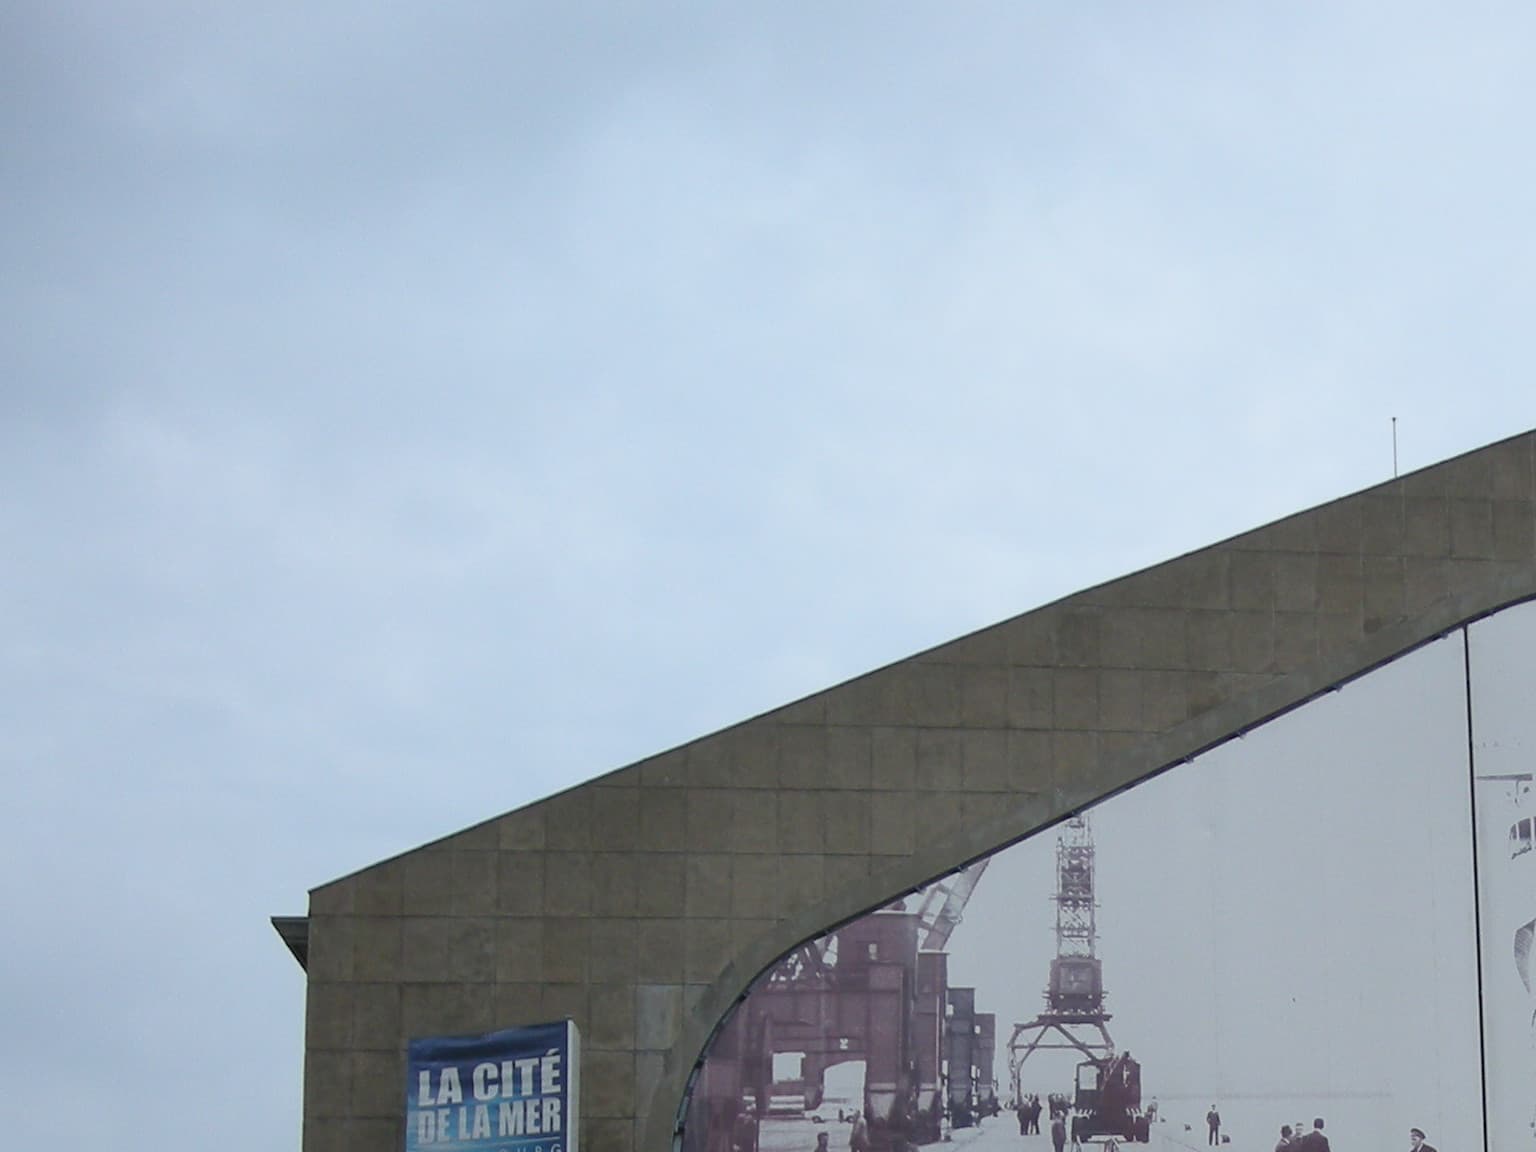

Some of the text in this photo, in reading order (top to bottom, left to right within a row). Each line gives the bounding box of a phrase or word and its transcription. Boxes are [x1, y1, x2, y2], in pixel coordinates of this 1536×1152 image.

[418, 1048, 561, 1108] LA CITÉ
[417, 1097, 562, 1145] DE LA MER
